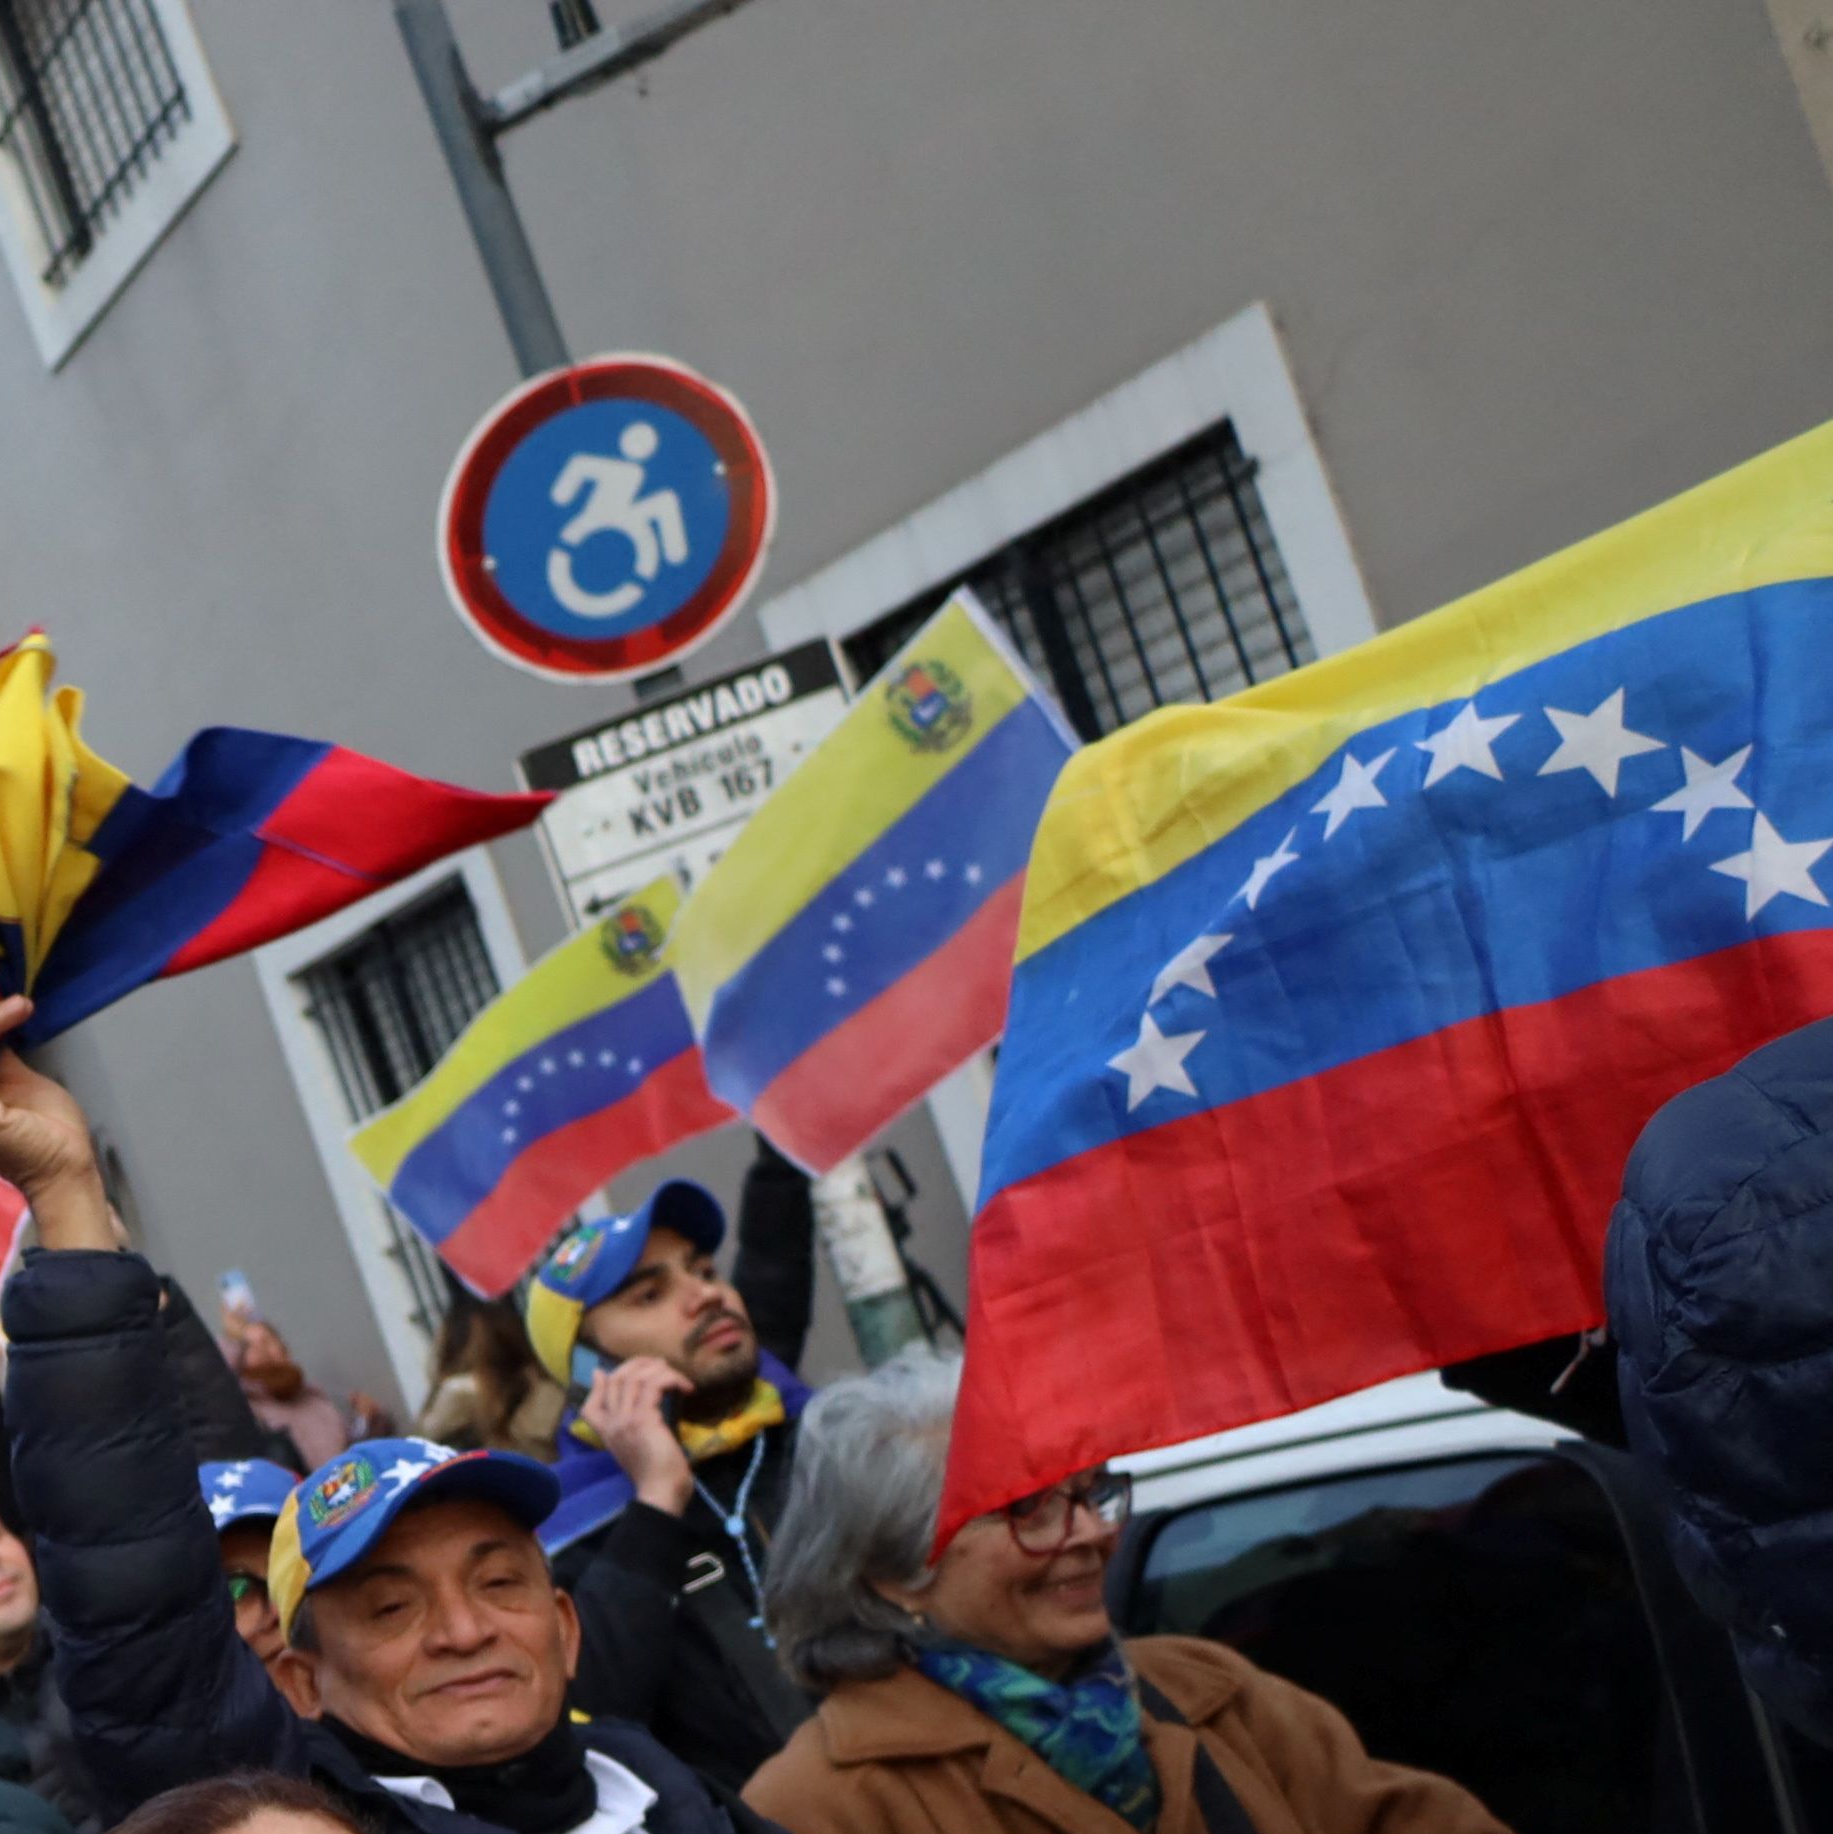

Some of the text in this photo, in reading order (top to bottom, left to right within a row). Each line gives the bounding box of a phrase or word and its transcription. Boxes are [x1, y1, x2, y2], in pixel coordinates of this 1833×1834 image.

[572, 664, 792, 778] RESERVADO
[628, 756, 774, 836] KVB 167
